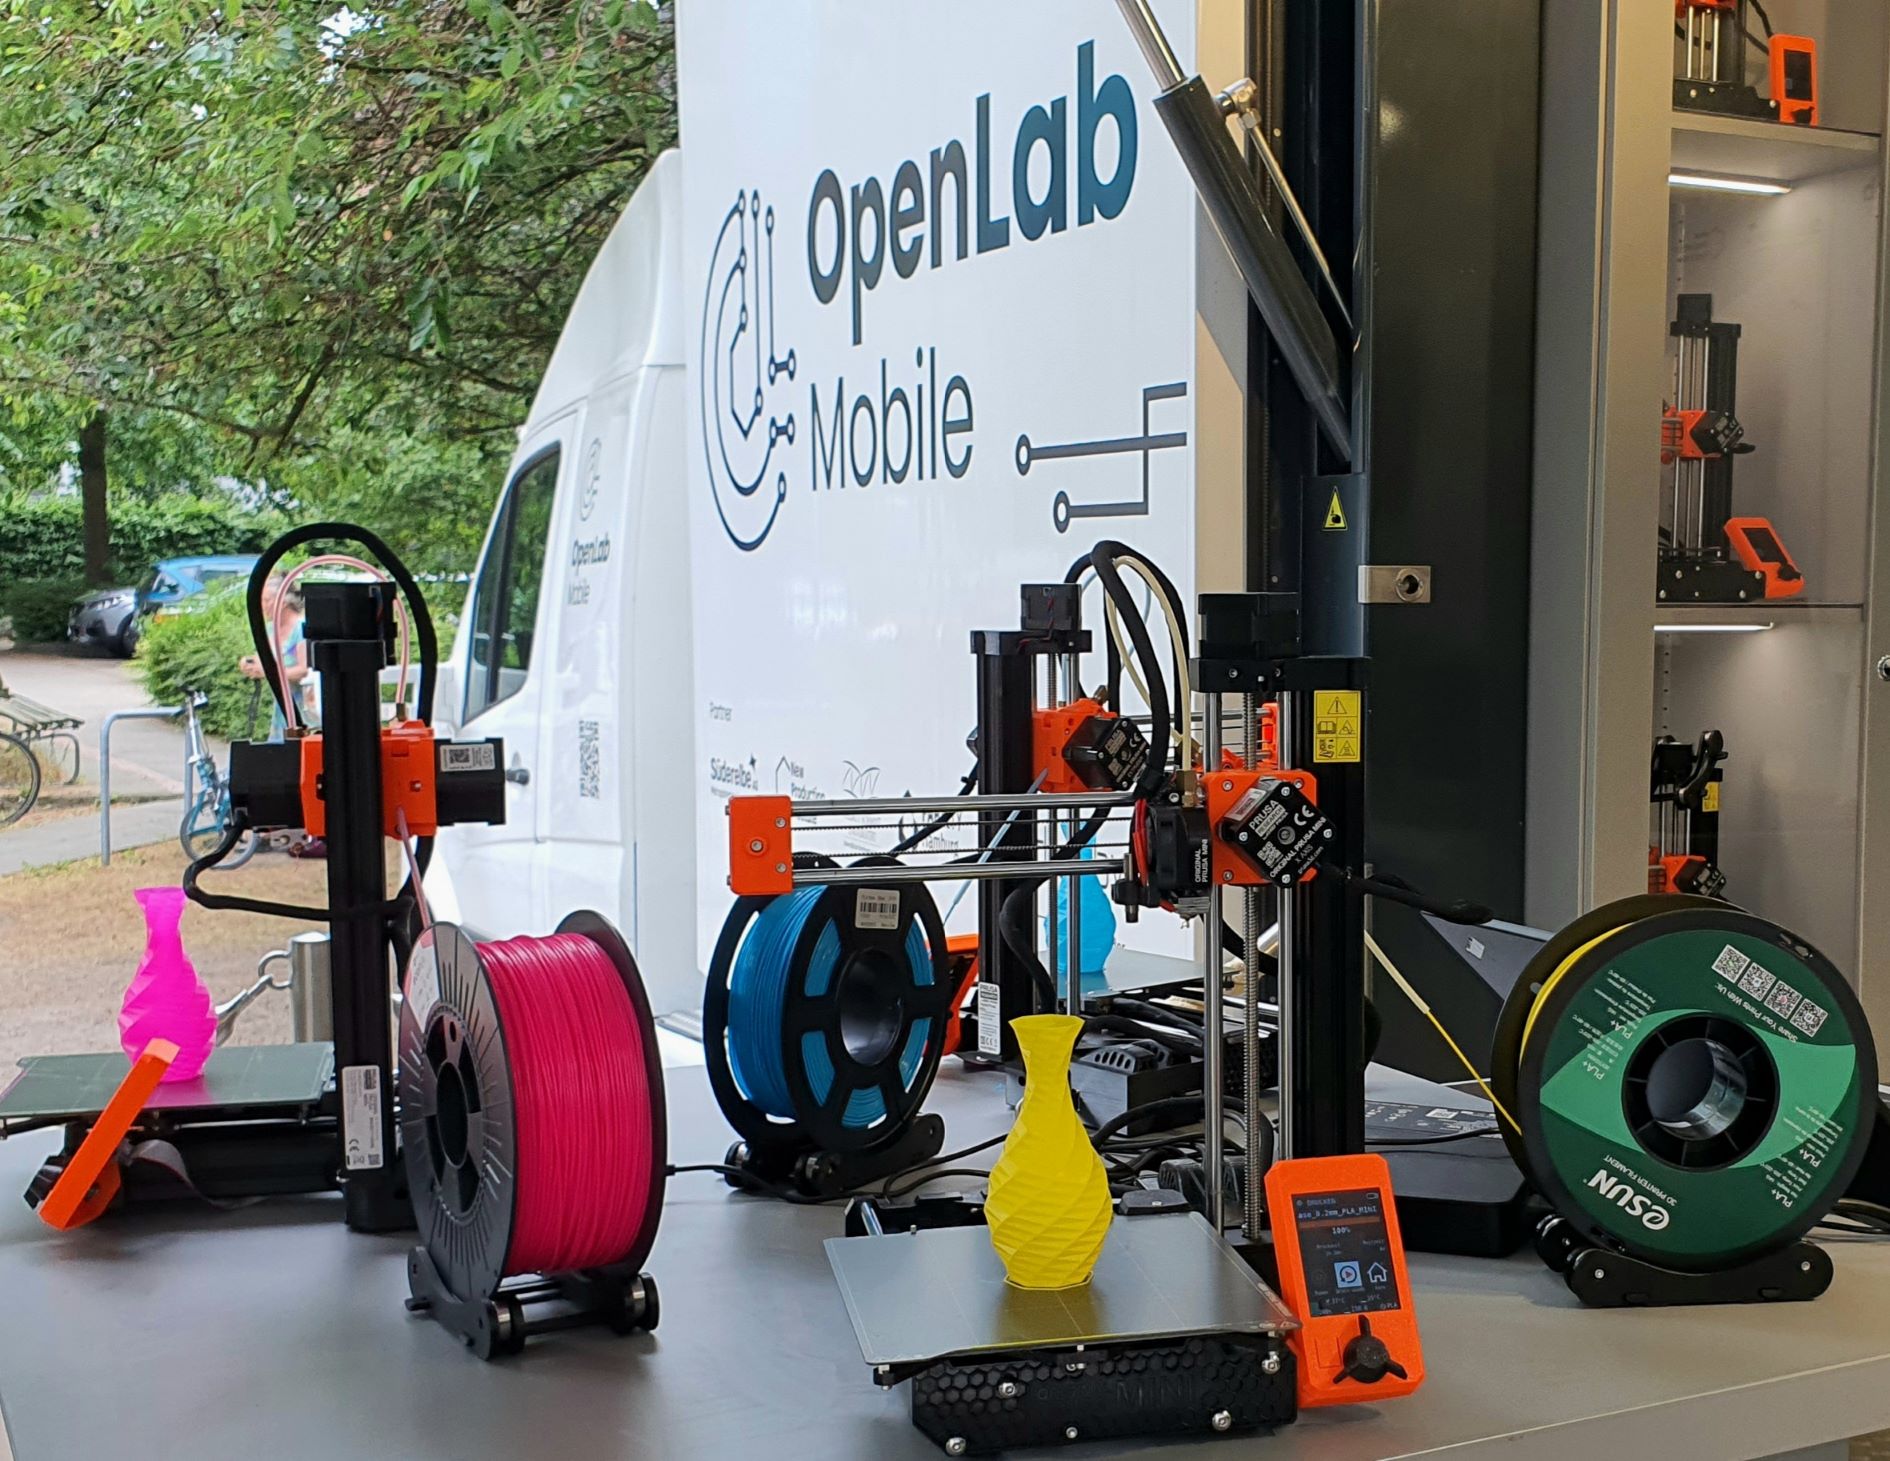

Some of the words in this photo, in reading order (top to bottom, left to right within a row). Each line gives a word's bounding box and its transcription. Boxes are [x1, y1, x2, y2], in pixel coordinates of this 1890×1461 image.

[807, 40, 1139, 345] OpenLab
[811, 346, 974, 491] Mobile
[1249, 800, 1279, 830] PRUSA
[1201, 838, 1209, 855] MINI
[1270, 850, 1297, 878] ORIGINAL
[1294, 830, 1315, 851] PRUSA
[1312, 816, 1326, 833] MINI
[1194, 849, 1202, 883] ORIGINAL
[1201, 858, 1209, 883] PRUSA
[1610, 1020, 1633, 1039] PLA+
[1761, 1014, 1777, 1030] Your
[1777, 1024, 1799, 1044] Share
[1603, 1154, 1638, 1181] FILAMENT
[1799, 1148, 1821, 1168] PLA+
[1587, 1169, 1670, 1230] eSUN
[1636, 1176, 1668, 1201] PRINTER
[1771, 1188, 1793, 1208] PLA+
[1666, 1196, 1678, 1207] 3D
